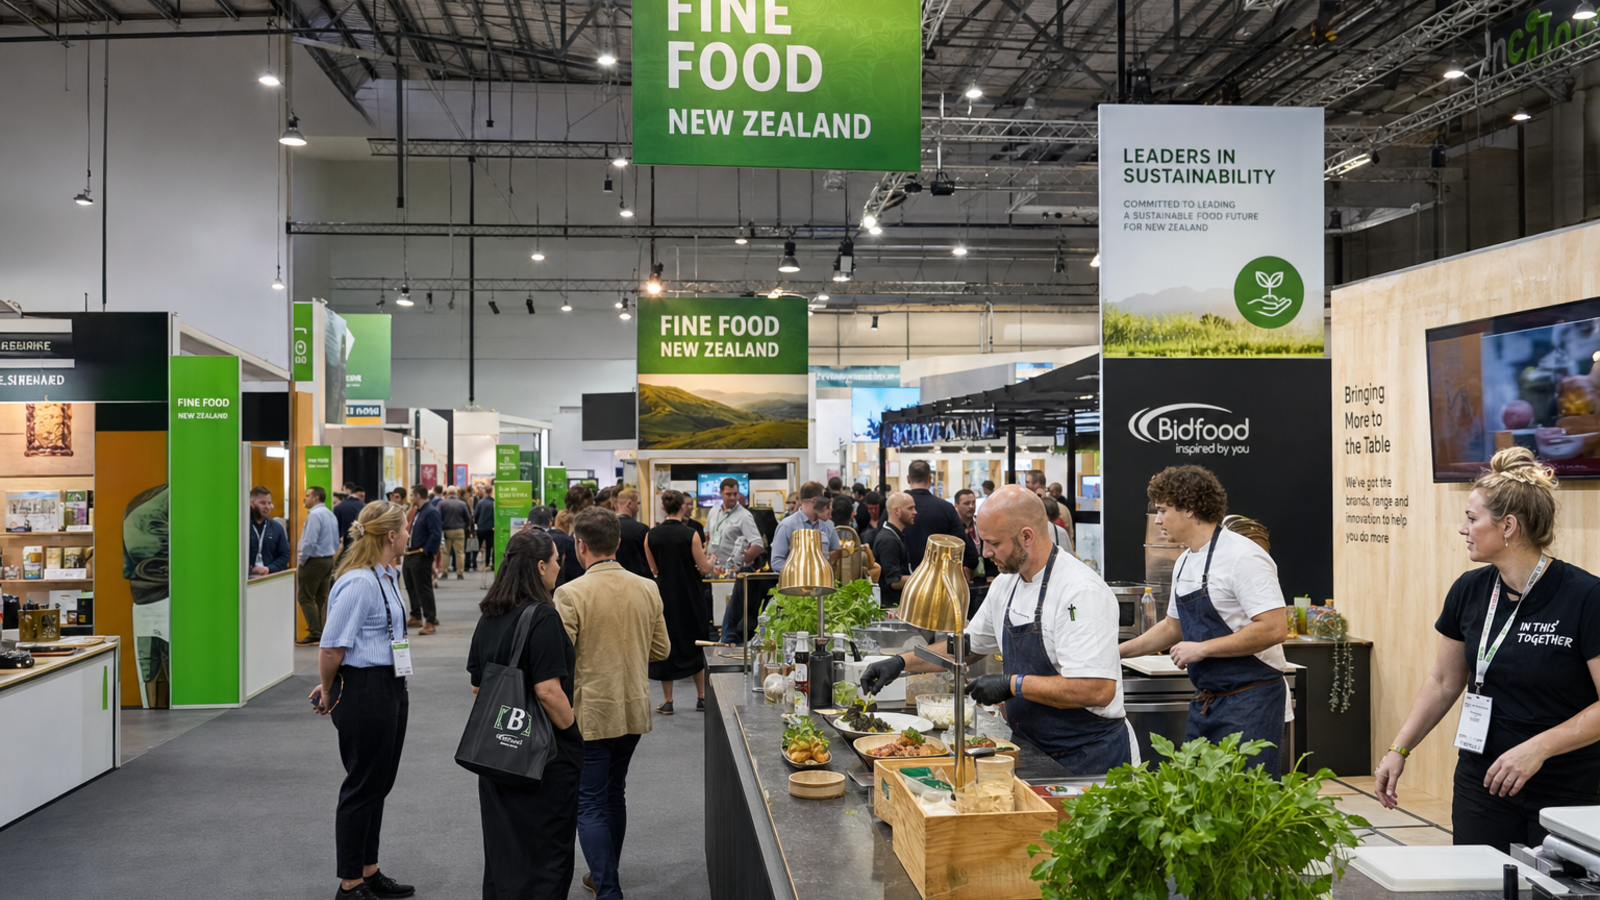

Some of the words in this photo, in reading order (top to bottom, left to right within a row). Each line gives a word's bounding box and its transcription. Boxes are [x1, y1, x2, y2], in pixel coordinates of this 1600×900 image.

[668, 0, 792, 35] FINE
[668, 40, 823, 92] FOOD
[668, 108, 734, 135] NEW
[743, 110, 871, 139] ZEALAND
[1123, 148, 1211, 164] LEADERS
[1217, 149, 1235, 164] IN
[1123, 168, 1276, 184] SUSTAINABILITY
[1123, 200, 1180, 208] COMMITTED
[1182, 200, 1195, 208] TO
[1197, 201, 1236, 209] LEADING
[1132, 212, 1194, 220] SUSTAINABLE
[1196, 212, 1223, 220] FOOD
[1123, 223, 1143, 231] FOR
[1145, 223, 1166, 231] NEW
[660, 315, 712, 336] FINE
[718, 315, 780, 336] FOOD
[660, 342, 699, 357] NEW
[704, 342, 780, 357] ZEALAND
[177, 398, 200, 407] FINE
[202, 398, 230, 407] FOOD
[1344, 383, 1385, 406] Bringing
[1345, 412, 1370, 429] More
[1372, 411, 1383, 427] to
[1158, 417, 1249, 441] Bidfood
[1175, 443, 1215, 456] inspired
[1217, 443, 1229, 456] by
[1231, 445, 1250, 456] you
[1345, 436, 1361, 455] the
[1363, 435, 1391, 454] Table
[1345, 476, 1366, 488] We've
[1367, 477, 1379, 490] got
[1380, 476, 1392, 488] the
[1345, 495, 1370, 507] brands,
[1372, 497, 1393, 509] range
[1394, 495, 1409, 507] and
[1345, 512, 1381, 525] innovation
[1382, 513, 1390, 525] to
[1391, 513, 1407, 528] help
[1346, 532, 1359, 543] you
[1359, 530, 1369, 542] do
[1370, 532, 1389, 543] more
[1519, 622, 1531, 631] IN
[1517, 633, 1574, 648] TOGETHER
[506, 707, 526, 730] B
